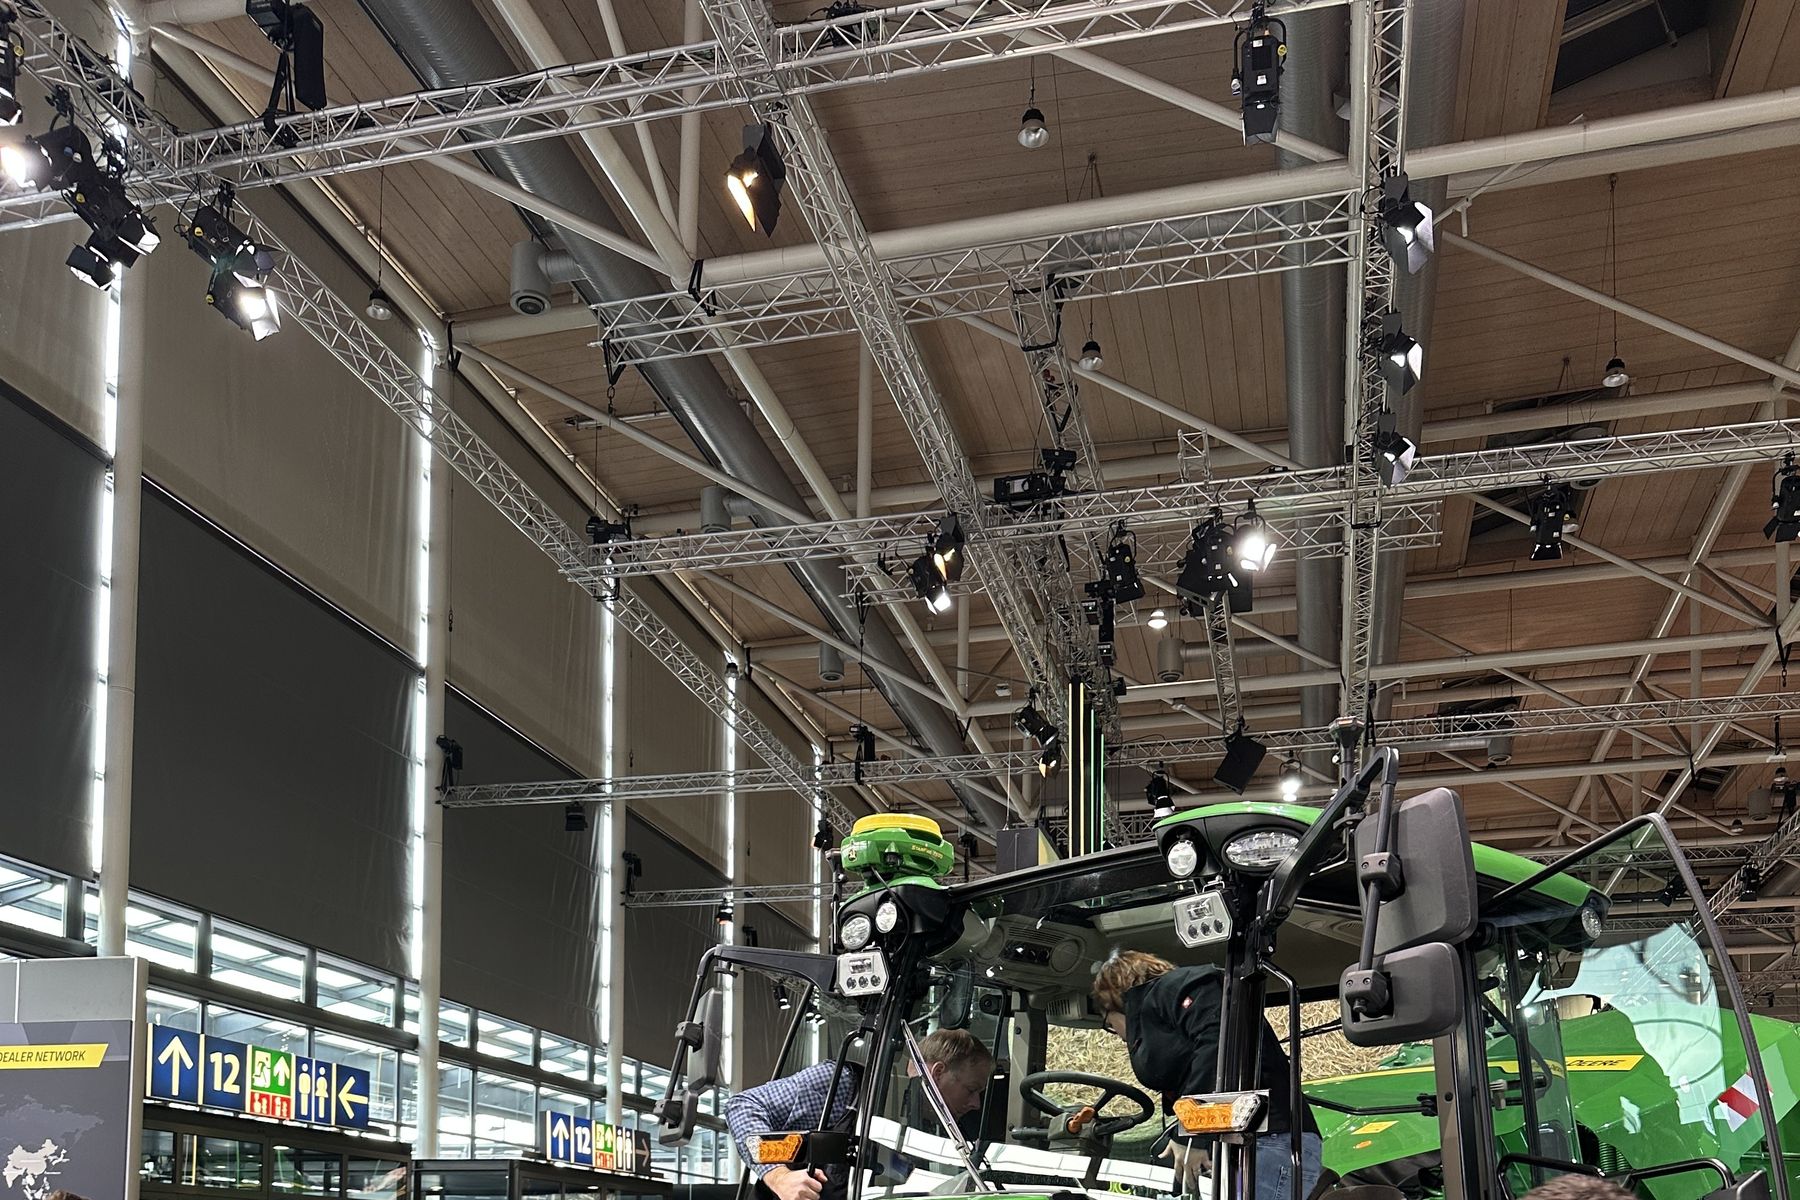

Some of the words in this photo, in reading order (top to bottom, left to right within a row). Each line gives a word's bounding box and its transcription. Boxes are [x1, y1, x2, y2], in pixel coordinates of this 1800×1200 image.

[35, 1050, 86, 1062] NETWORK
[209, 1051, 241, 1095] 12
[575, 1125, 592, 1155] 12
